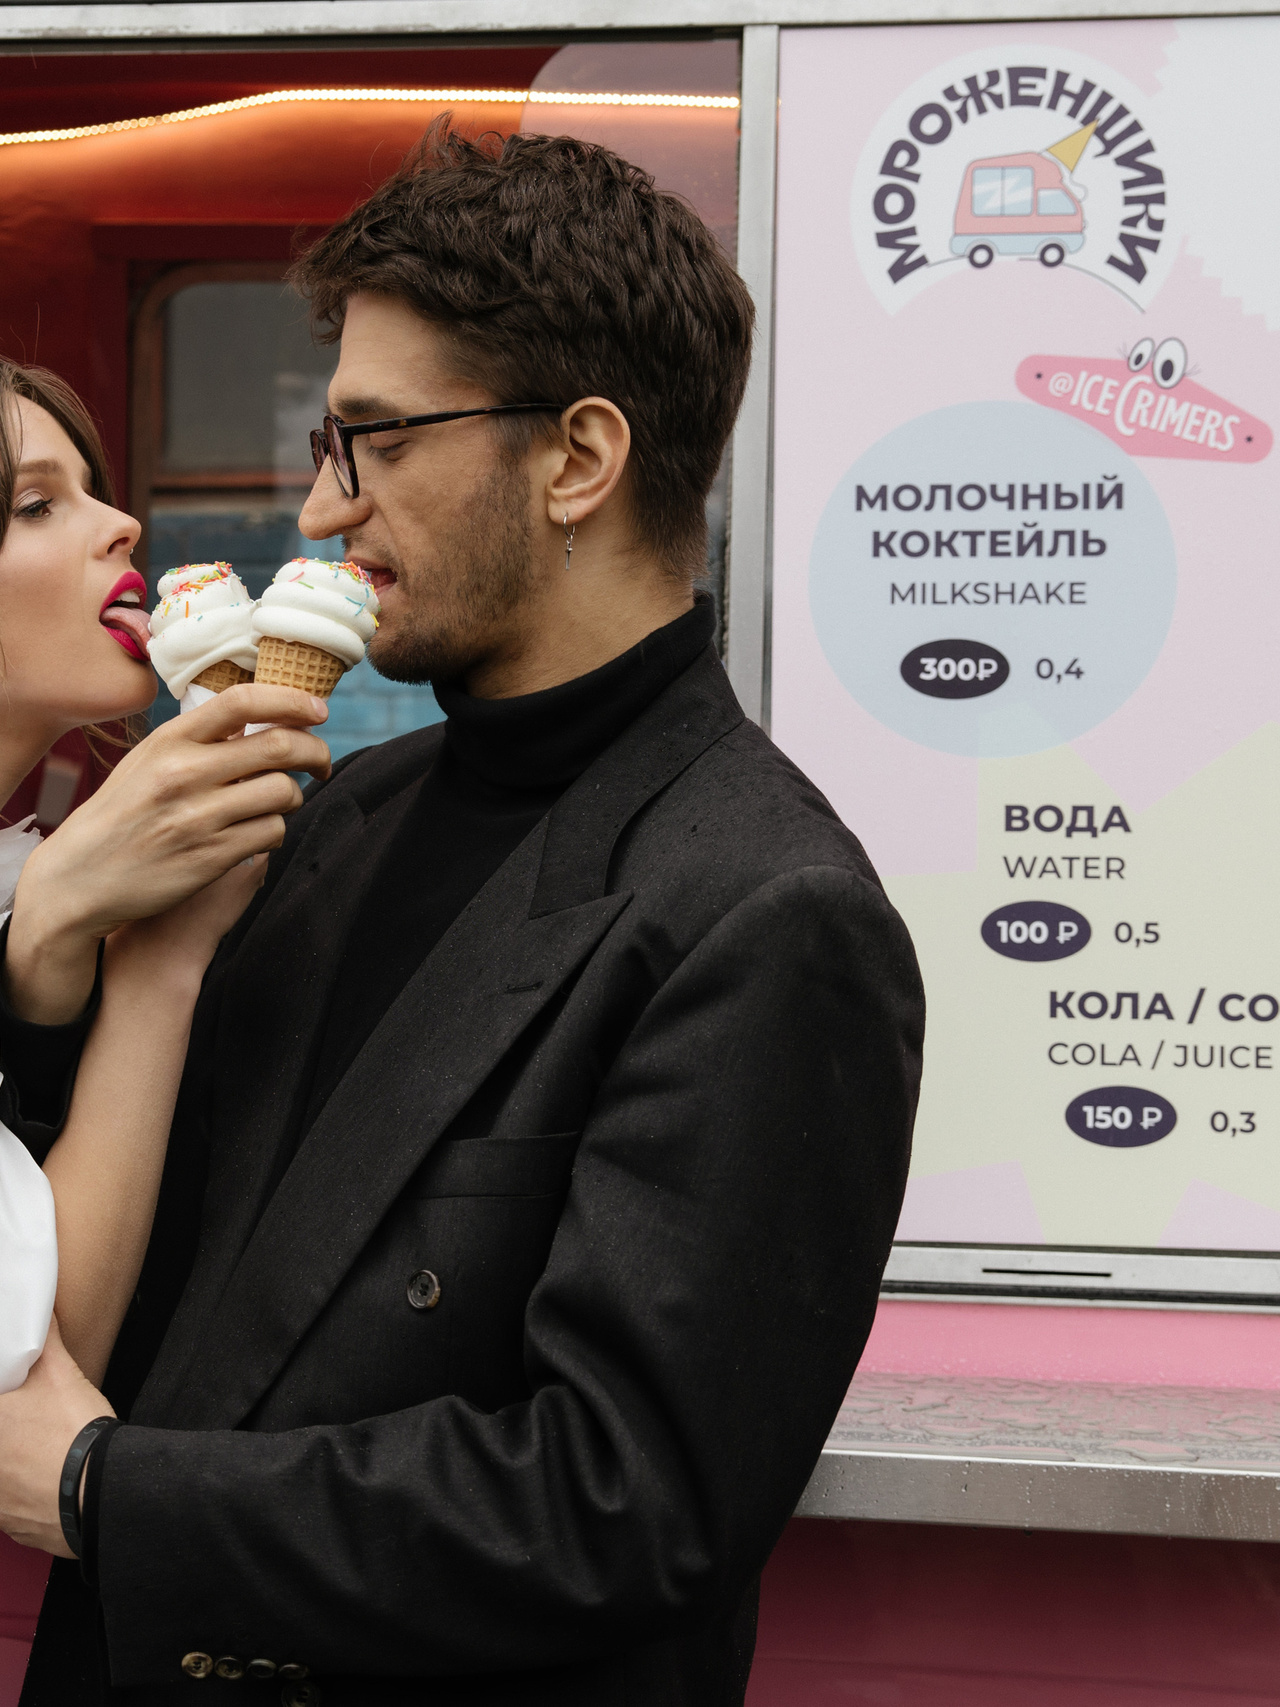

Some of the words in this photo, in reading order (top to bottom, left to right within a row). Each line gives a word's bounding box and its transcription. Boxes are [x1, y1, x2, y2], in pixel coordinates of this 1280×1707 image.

[873, 66, 1166, 285] МОРОЖЕНЩИКИ
[855, 474, 1124, 512] МОЛОЧНЫЙ
[872, 522, 1107, 558] КОКТЕЙЛЬ
[891, 582, 1086, 605] MILKSHAKE
[1035, 658, 1084, 683] 0,4
[1004, 804, 1132, 838] ВОДА
[1003, 856, 1125, 879] WATER
[1114, 922, 1160, 947] 0,5
[1049, 991, 1175, 1020] КОЛА
[1187, 988, 1206, 1024] /
[1047, 1042, 1142, 1066] COLA
[1151, 1040, 1165, 1070] /
[1173, 1044, 1273, 1069] JUICE
[1210, 1111, 1256, 1136] 0,3
